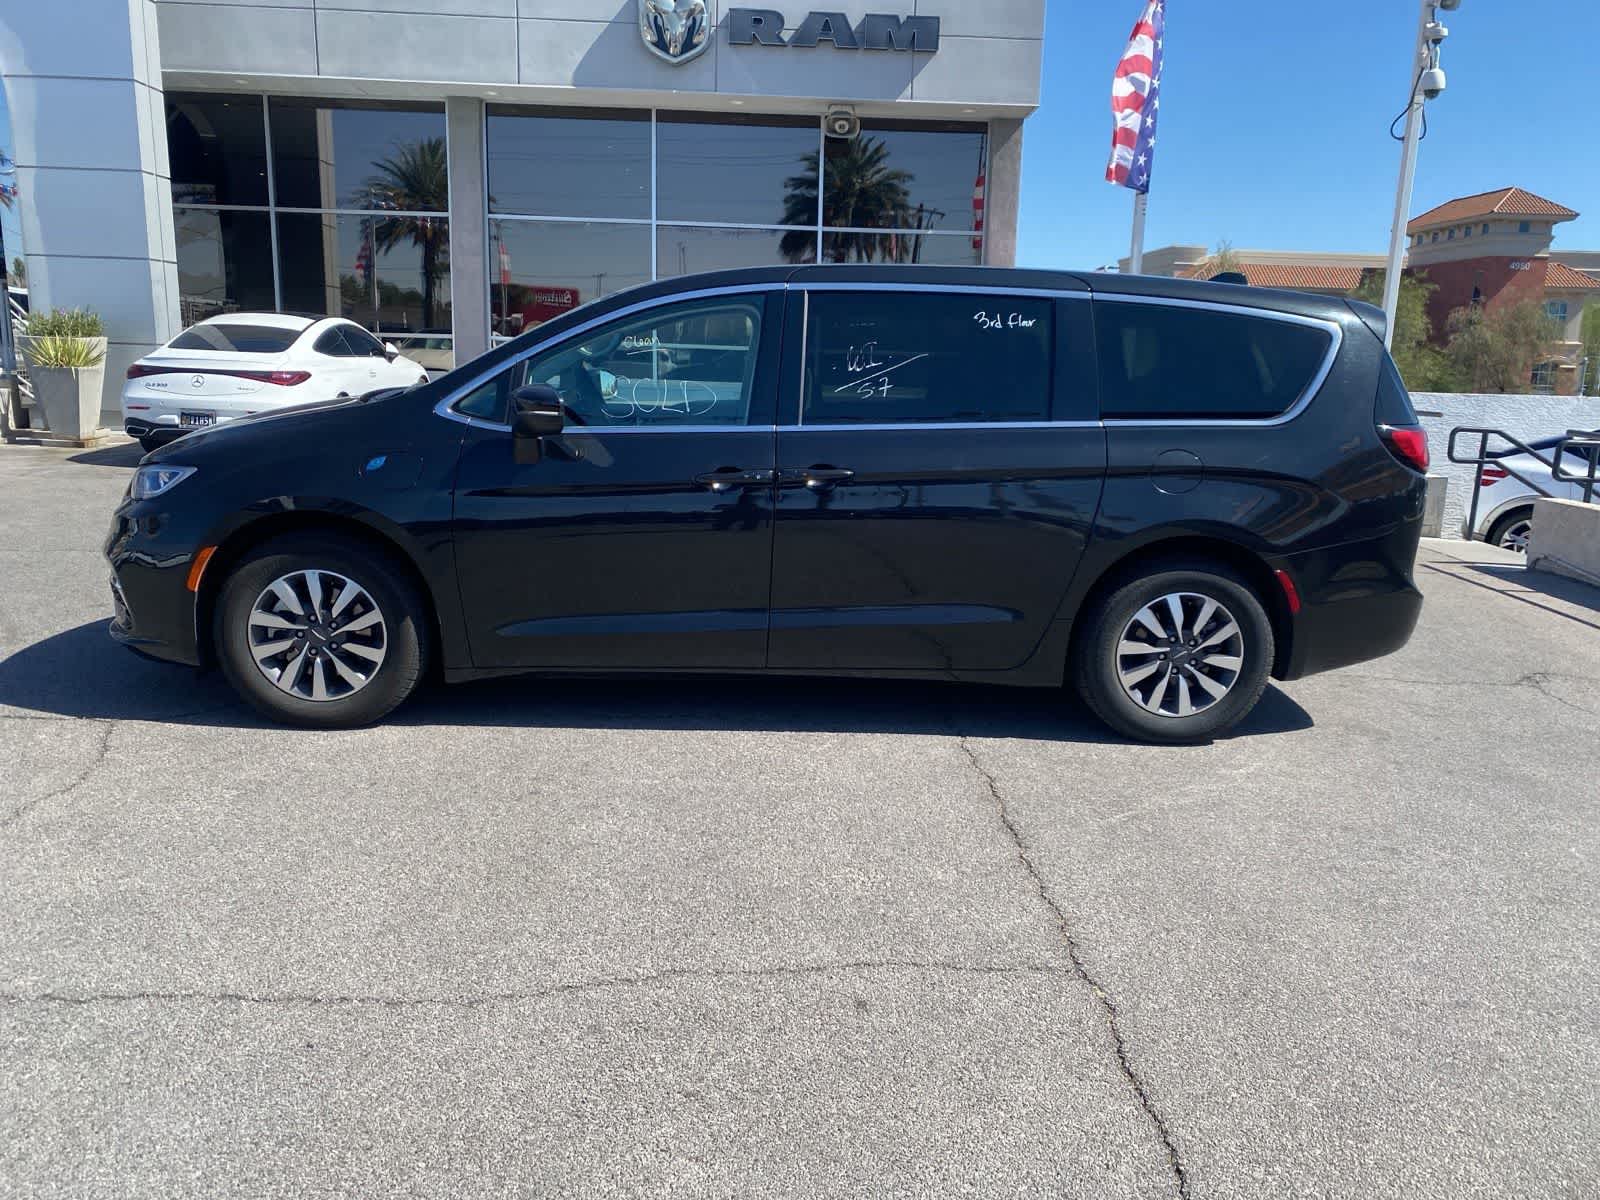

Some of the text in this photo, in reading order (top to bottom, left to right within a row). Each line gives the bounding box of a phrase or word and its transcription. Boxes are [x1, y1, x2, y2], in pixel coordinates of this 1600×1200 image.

[728, 8, 940, 52] RAM
[973, 311, 1003, 328] 3rd
[601, 375, 717, 418] SOLD
